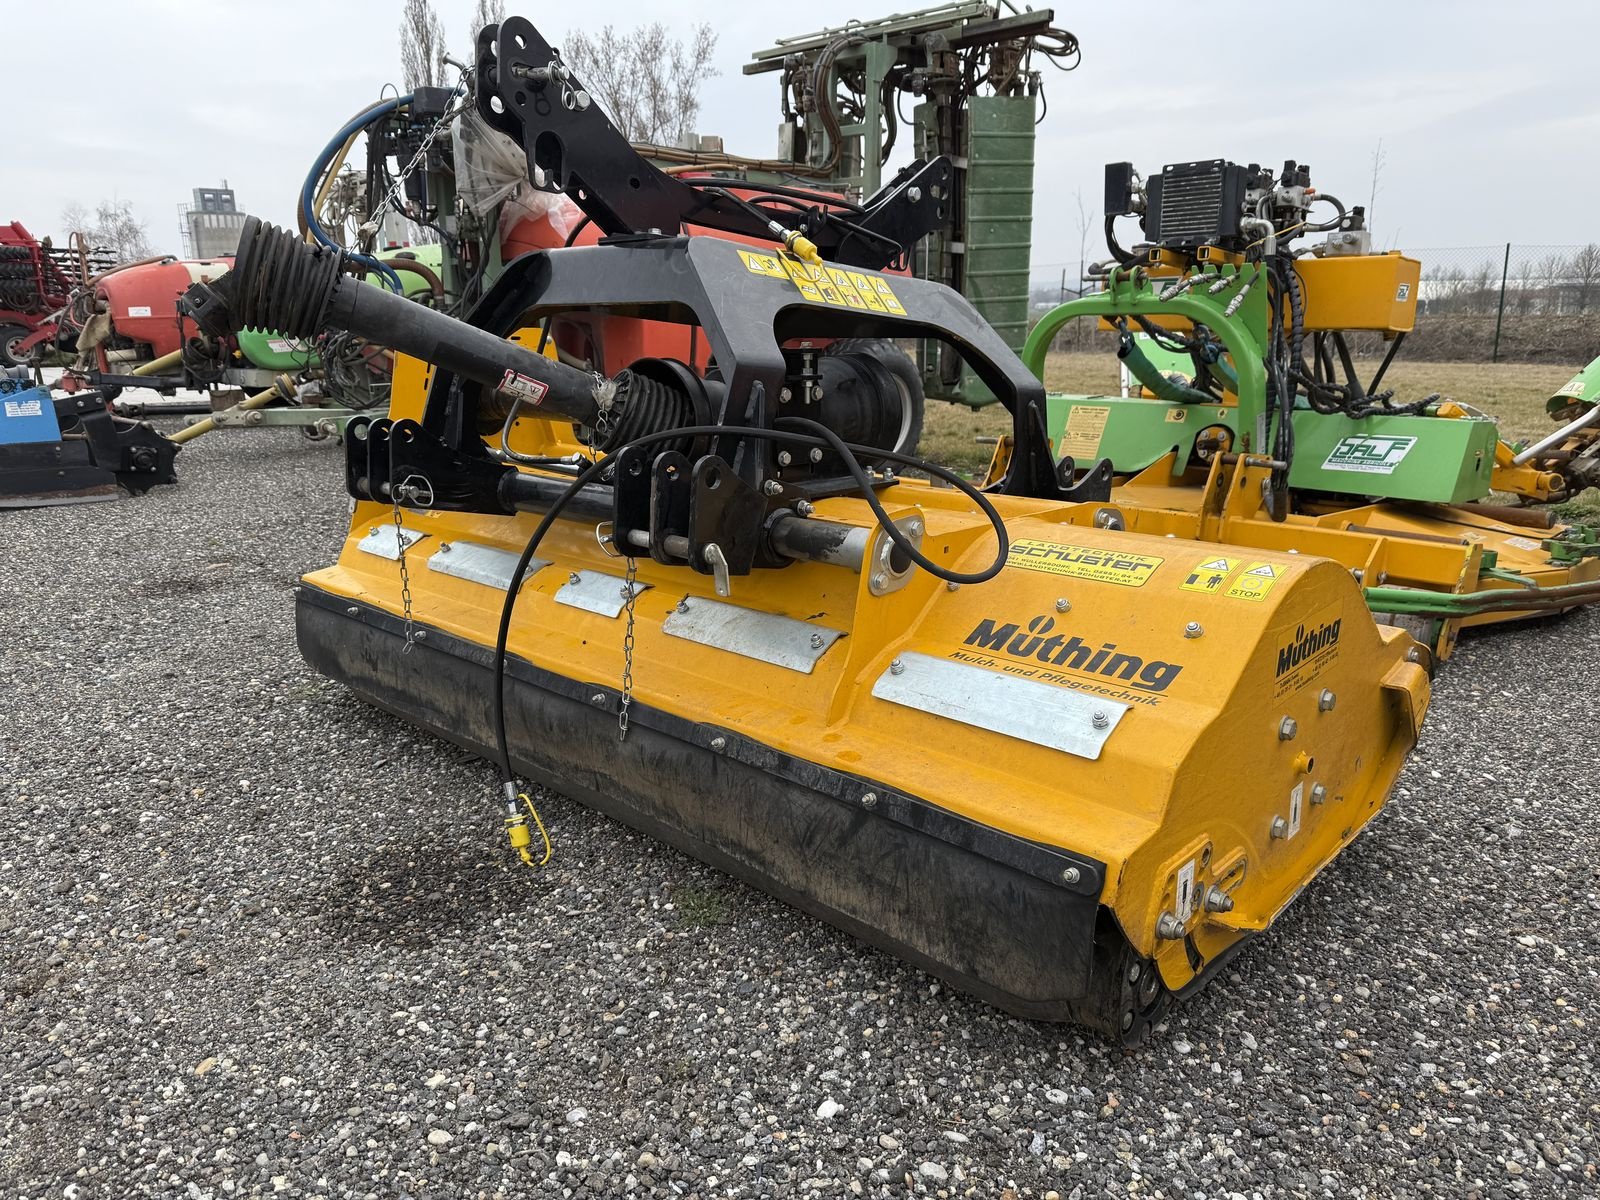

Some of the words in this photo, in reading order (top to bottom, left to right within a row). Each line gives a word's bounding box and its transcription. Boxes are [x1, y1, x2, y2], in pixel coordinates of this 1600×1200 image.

[1027, 541, 1148, 562] LANDTECHNIK
[1230, 588, 1261, 598] STOP
[949, 651, 999, 667] Mulch-
[1003, 664, 1039, 678] und
[1038, 671, 1161, 707] Pflegetechnik
